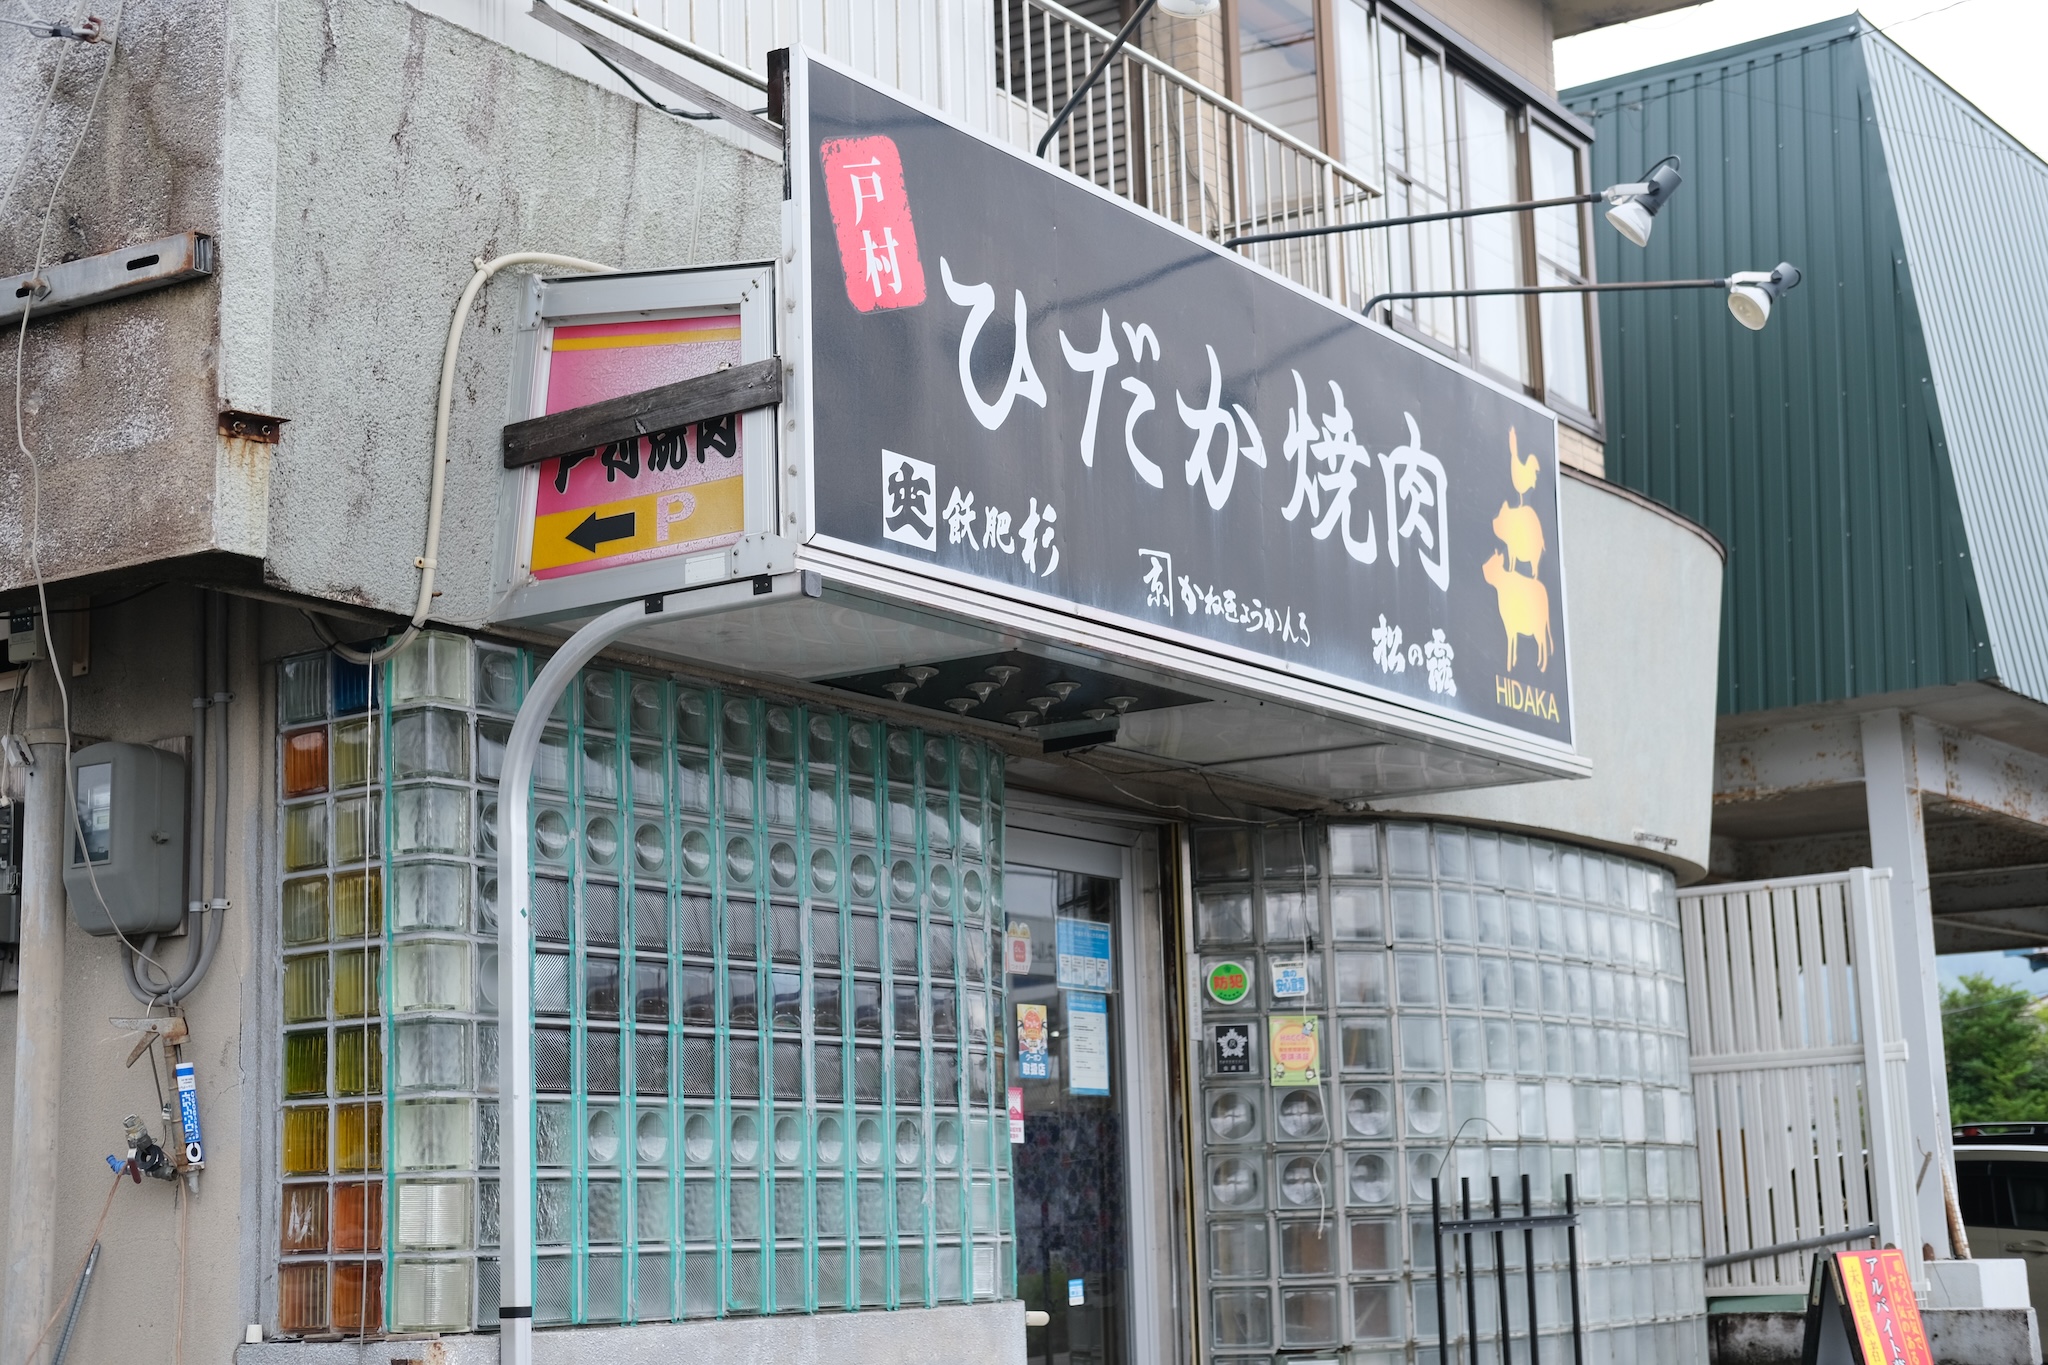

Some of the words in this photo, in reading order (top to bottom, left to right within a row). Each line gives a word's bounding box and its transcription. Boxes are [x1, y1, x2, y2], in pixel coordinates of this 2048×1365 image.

[843, 156, 902, 298] 戸村
[940, 256, 1450, 592] ひだか焼肉
[656, 491, 696, 542] P
[942, 486, 1060, 577] 飫肥杉
[1495, 674, 1560, 724] HIDAKA
[1213, 974, 1243, 991] 防犯
